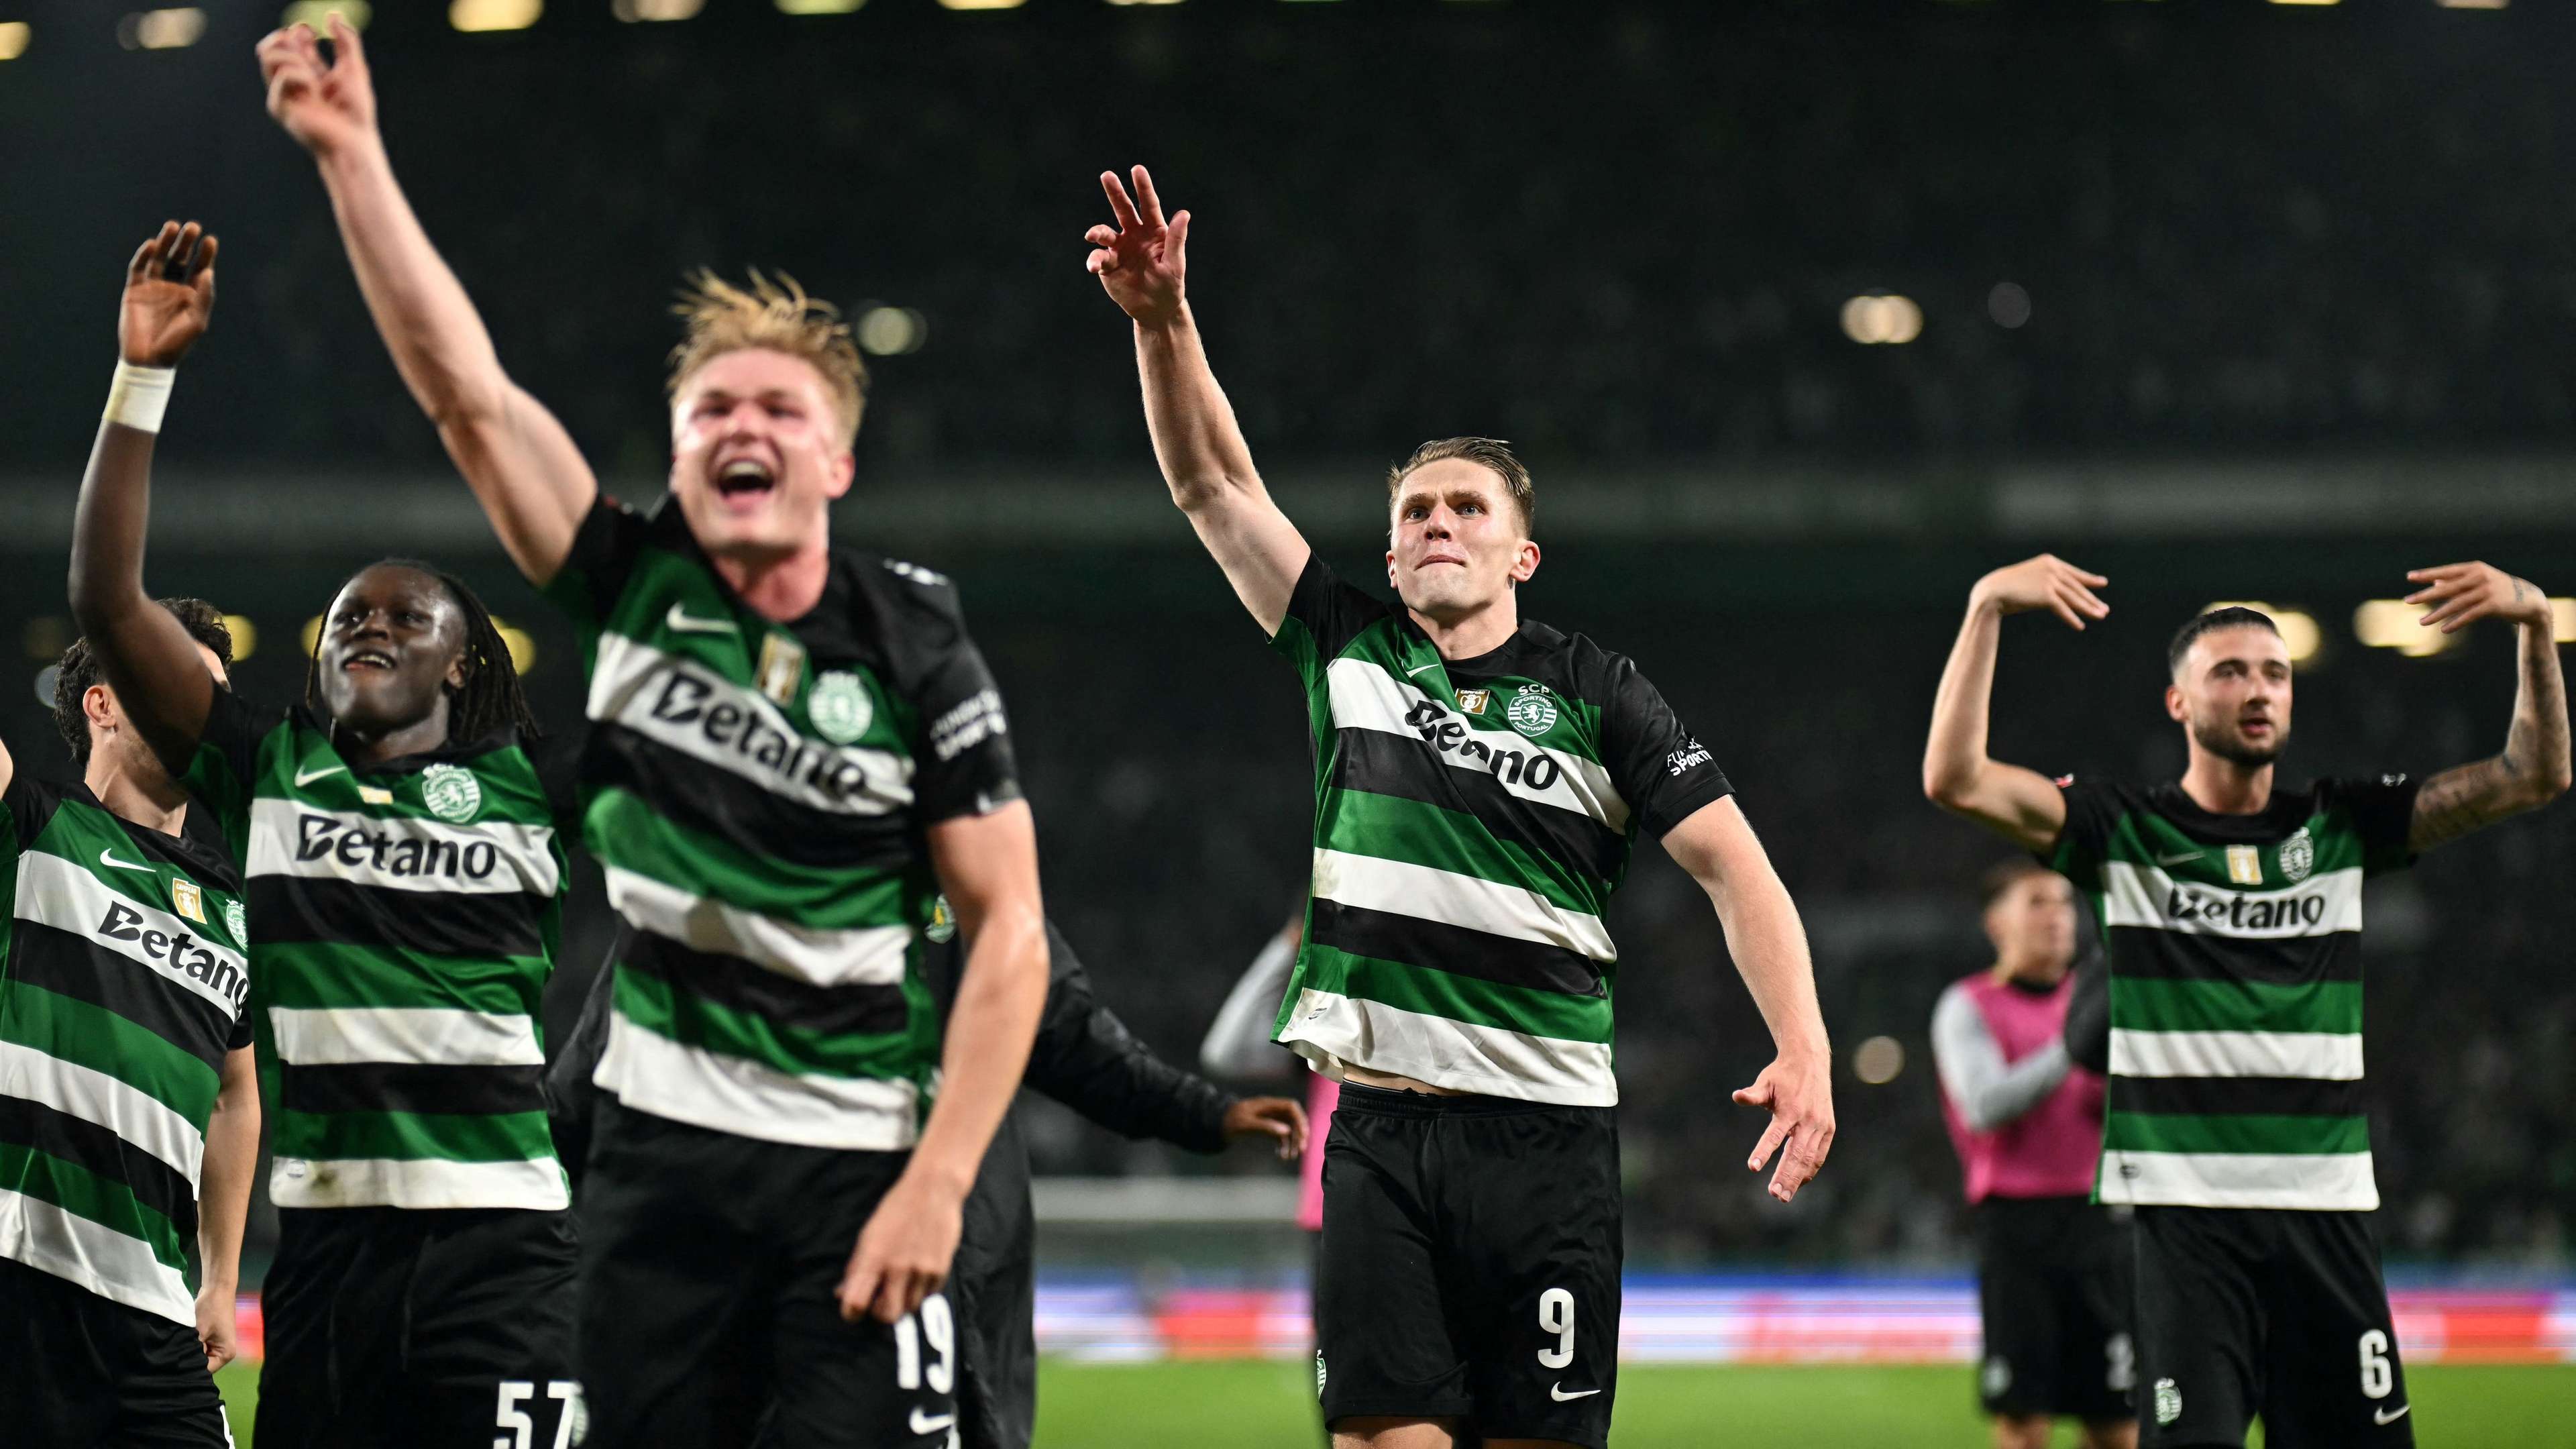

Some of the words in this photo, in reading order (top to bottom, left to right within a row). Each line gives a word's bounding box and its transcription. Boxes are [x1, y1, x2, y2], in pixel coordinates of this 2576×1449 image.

[1514, 696, 1552, 708] SPORTING
[1518, 684, 1550, 696] SCP
[651, 672, 866, 796] Betano
[1405, 700, 1559, 790] Beano
[1514, 721, 1549, 731] PORTUGAL
[296, 813, 496, 879] Betano
[2169, 884, 2325, 930] Betano
[97, 900, 248, 1011] Betano
[894, 1293, 955, 1394] 19
[1538, 1287, 1574, 1369] 9
[2359, 1328, 2394, 1399] 6
[493, 1381, 578, 1449] 57
